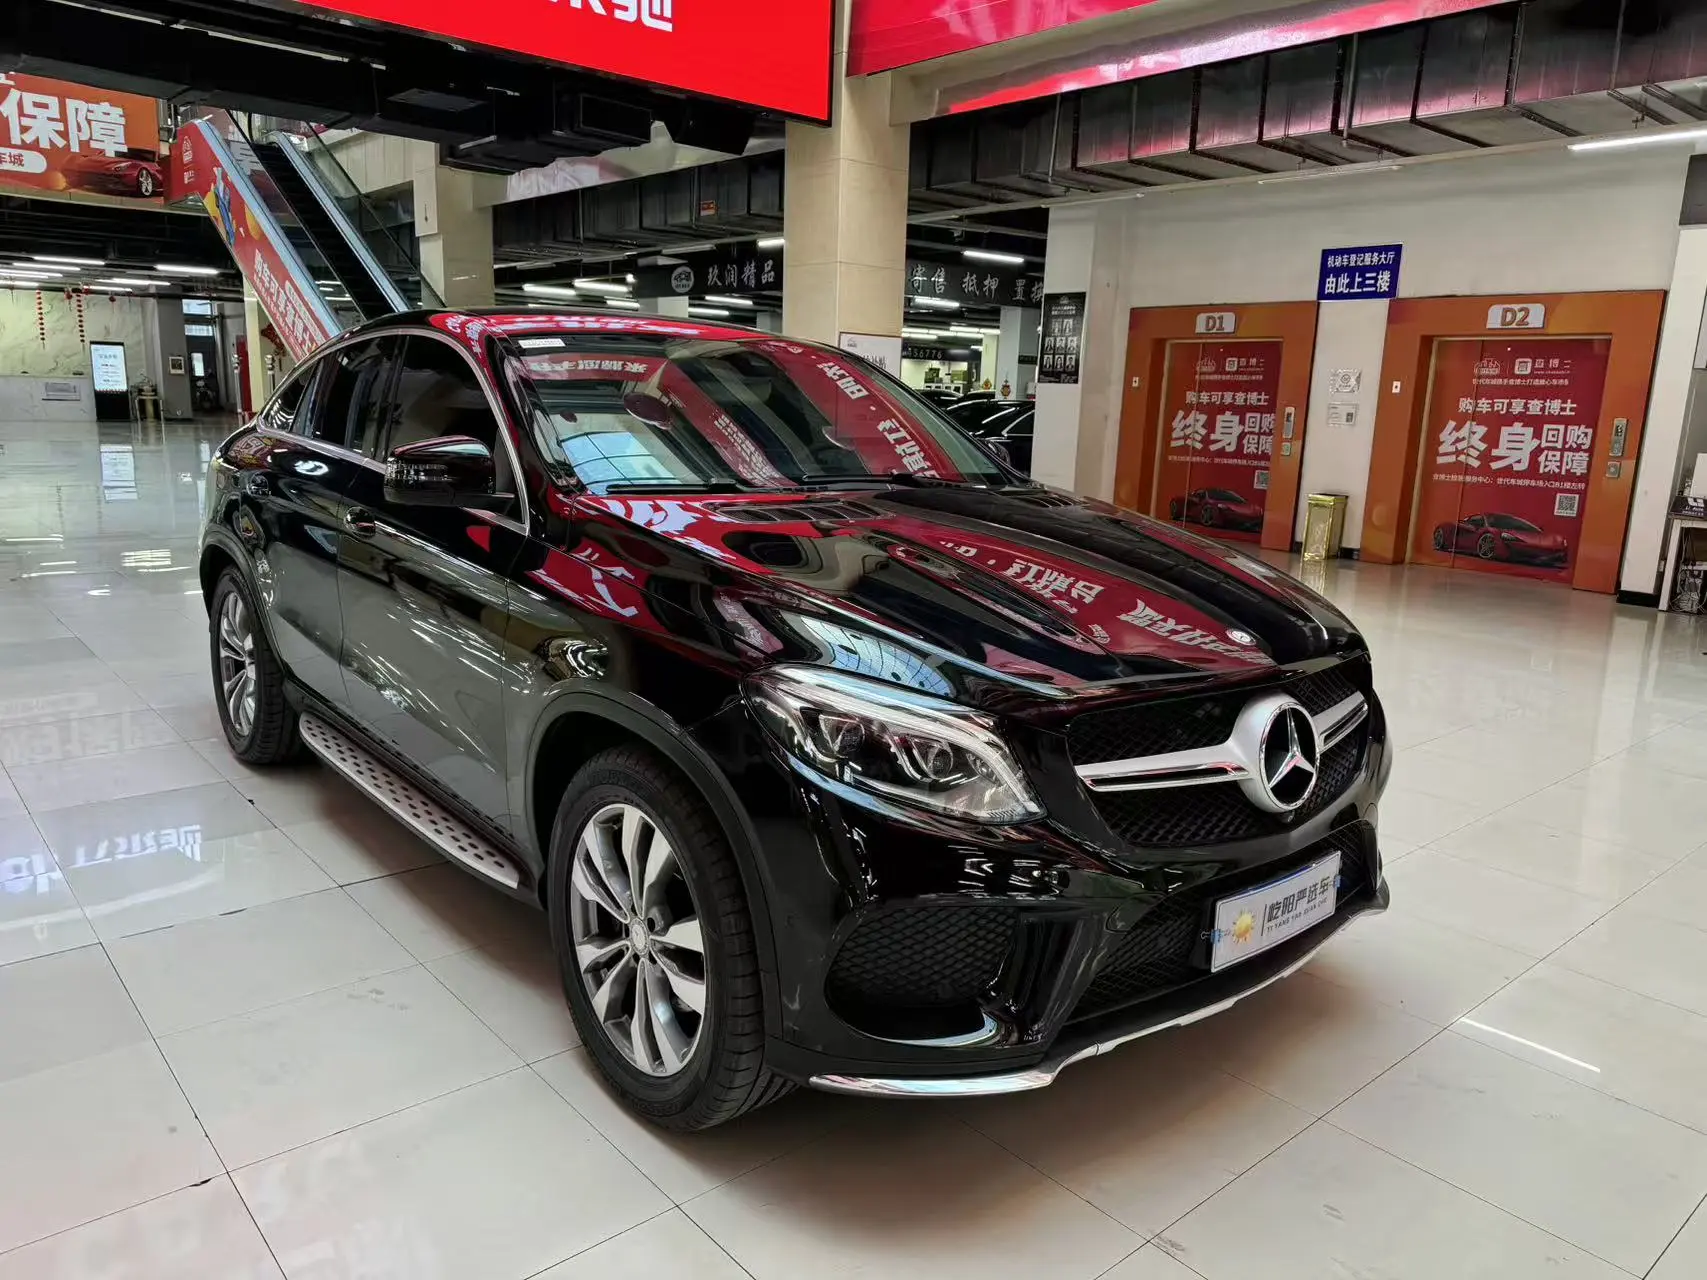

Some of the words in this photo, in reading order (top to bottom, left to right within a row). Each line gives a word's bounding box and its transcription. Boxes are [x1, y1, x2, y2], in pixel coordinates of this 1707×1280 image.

[0, 88, 128, 157] 保障
[1327, 251, 1395, 268] 机动车登记服务大厅
[707, 259, 775, 288] 玖润精品
[911, 264, 946, 294] 寄售
[962, 271, 999, 298] 抵押
[1325, 270, 1391, 294] 由此上三楼
[1204, 315, 1225, 332] D1
[1500, 306, 1531, 327] D2
[1185, 391, 1269, 405] 购车可享查博士
[1458, 397, 1577, 416] 购车可享查博士
[1170, 409, 1244, 452] 终身
[1541, 424, 1593, 450] 回购
[1436, 420, 1540, 471] 终身
[1538, 449, 1590, 476] 保障
